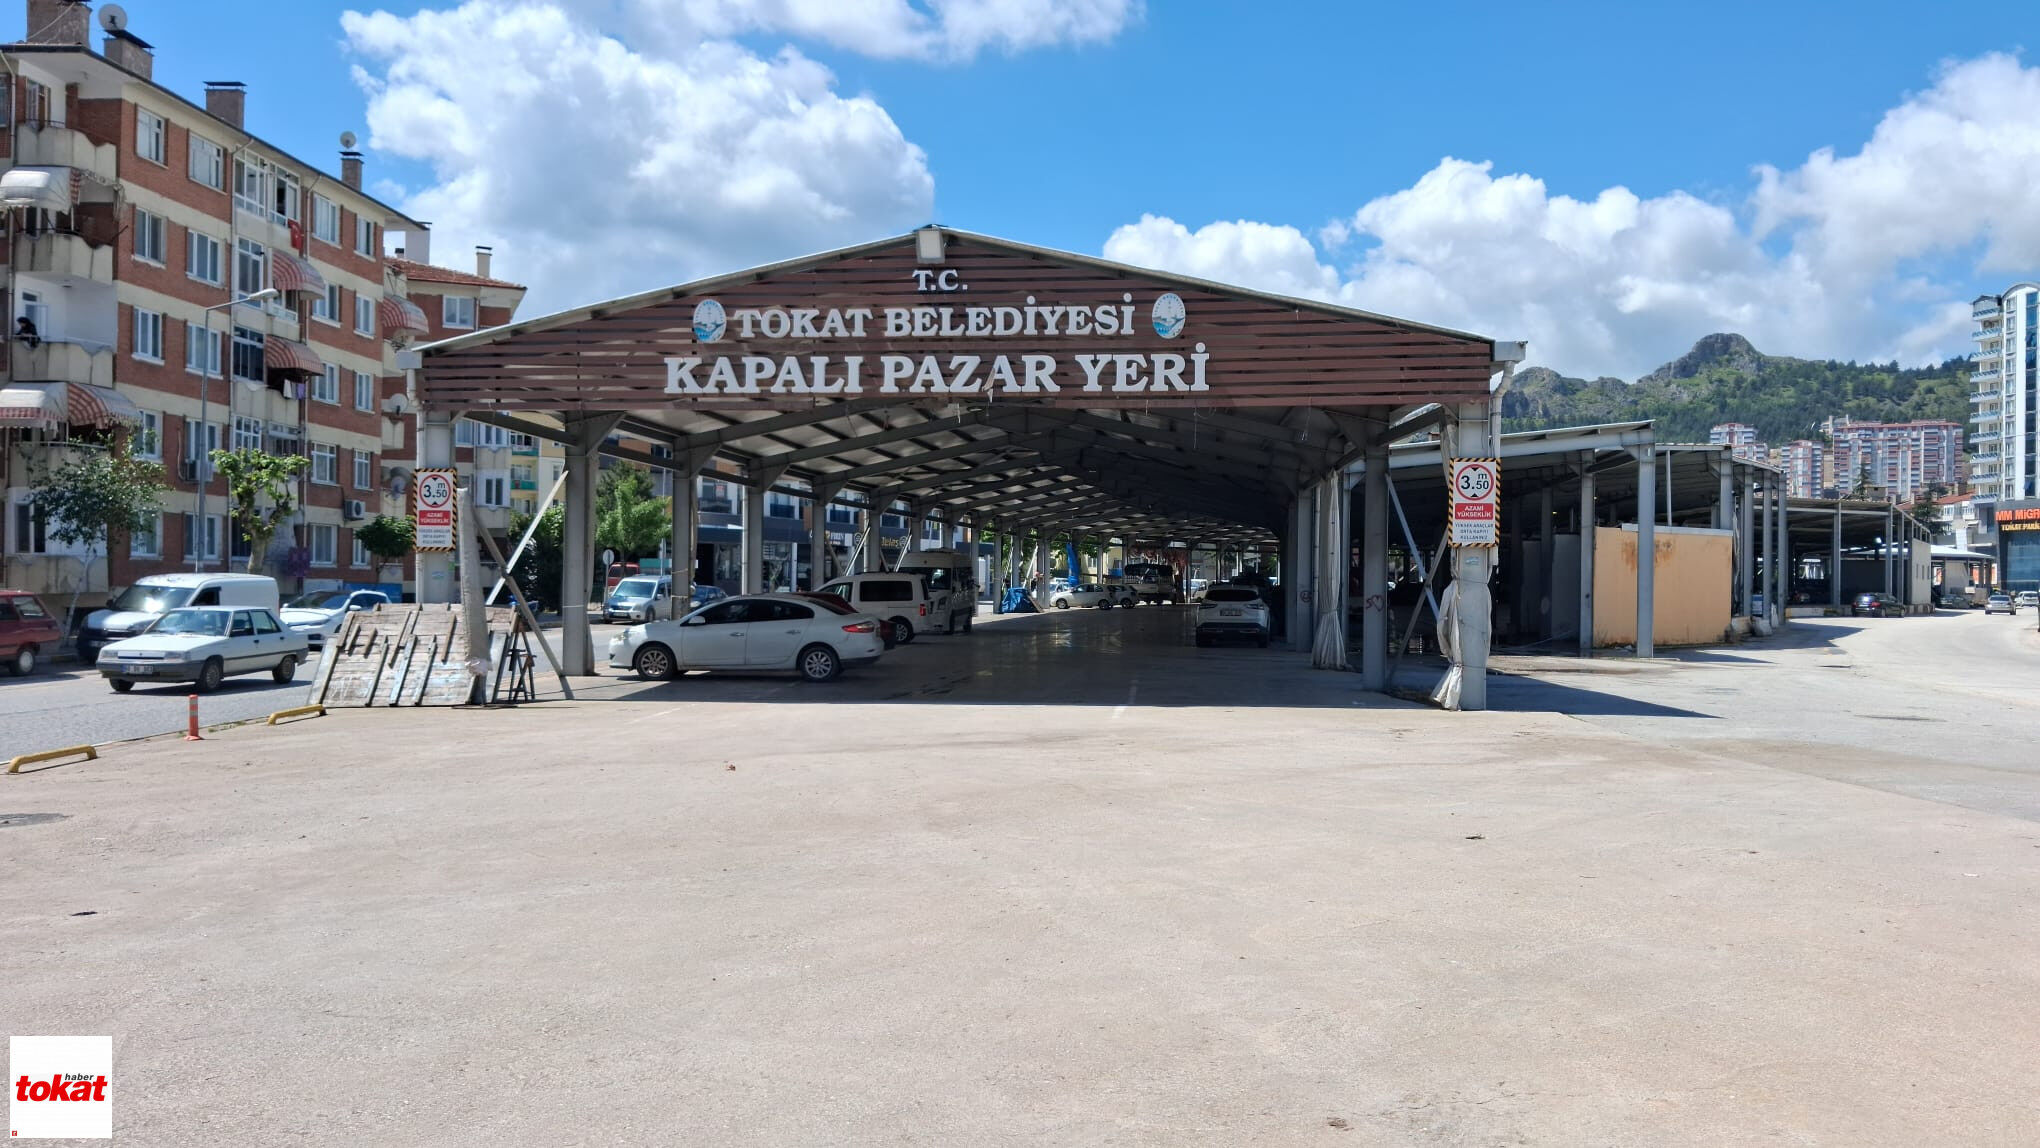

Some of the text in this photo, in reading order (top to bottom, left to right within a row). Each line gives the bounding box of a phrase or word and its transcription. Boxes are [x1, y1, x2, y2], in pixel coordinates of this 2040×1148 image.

[912, 269, 968, 291] T.C.
[733, 307, 873, 338] TOKAT
[884, 292, 1136, 337] BELEDİYESİ
[663, 341, 1210, 394] KAPALI PAZAR YERİ
